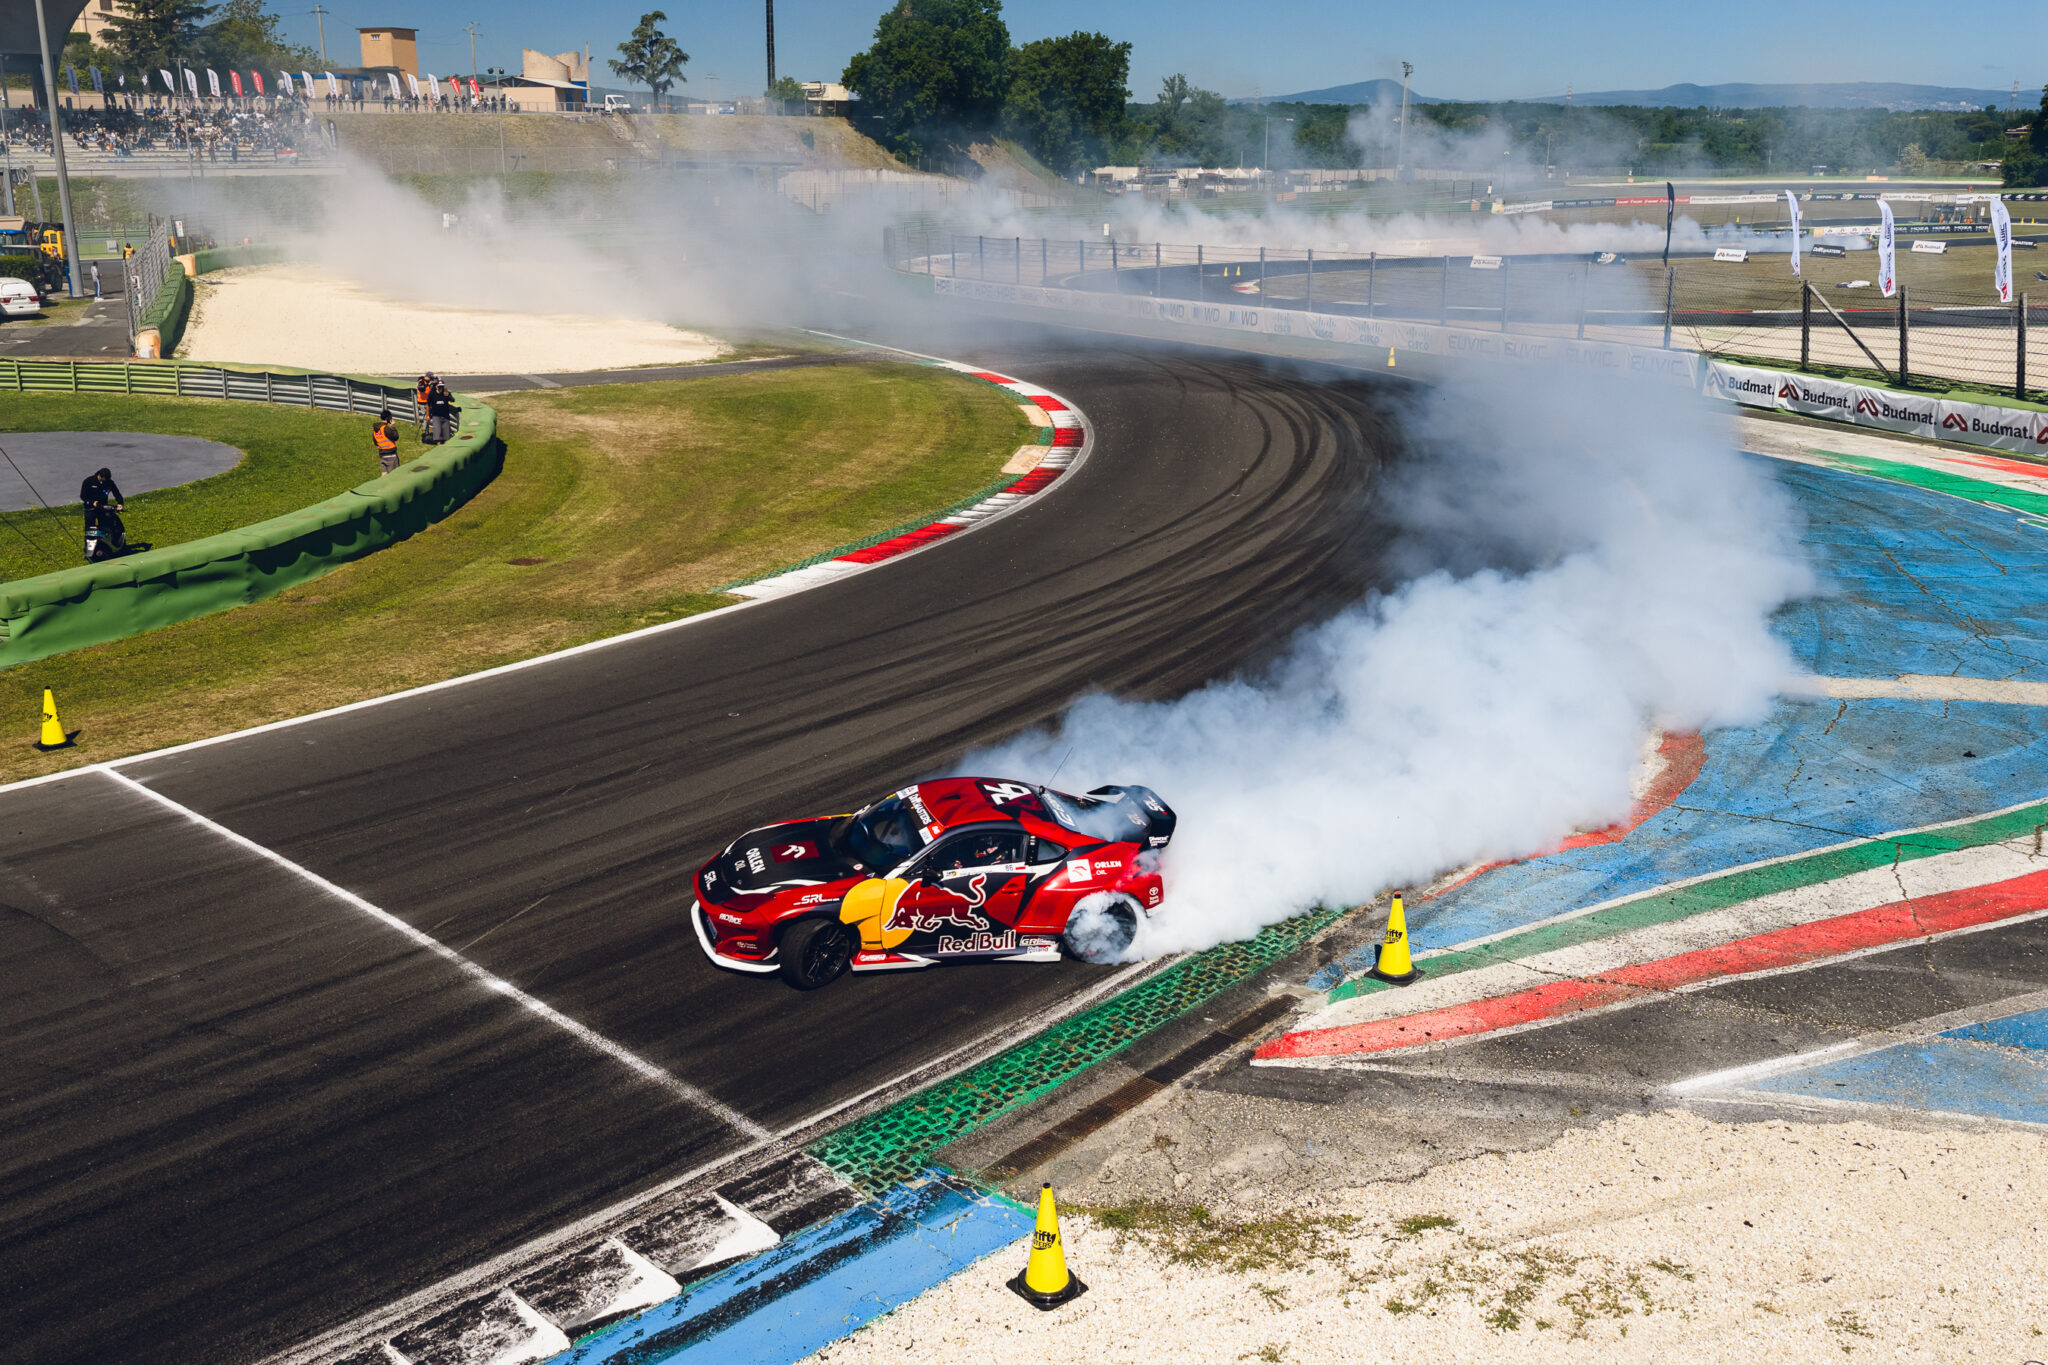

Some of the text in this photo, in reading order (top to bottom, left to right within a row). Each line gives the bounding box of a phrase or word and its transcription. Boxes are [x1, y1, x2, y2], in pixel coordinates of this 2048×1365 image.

[1241, 311, 1258, 326] WD
[746, 847, 766, 875] ORLEN
[1094, 860, 1122, 869] ORLEN
[938, 929, 1017, 954] Red Bull
